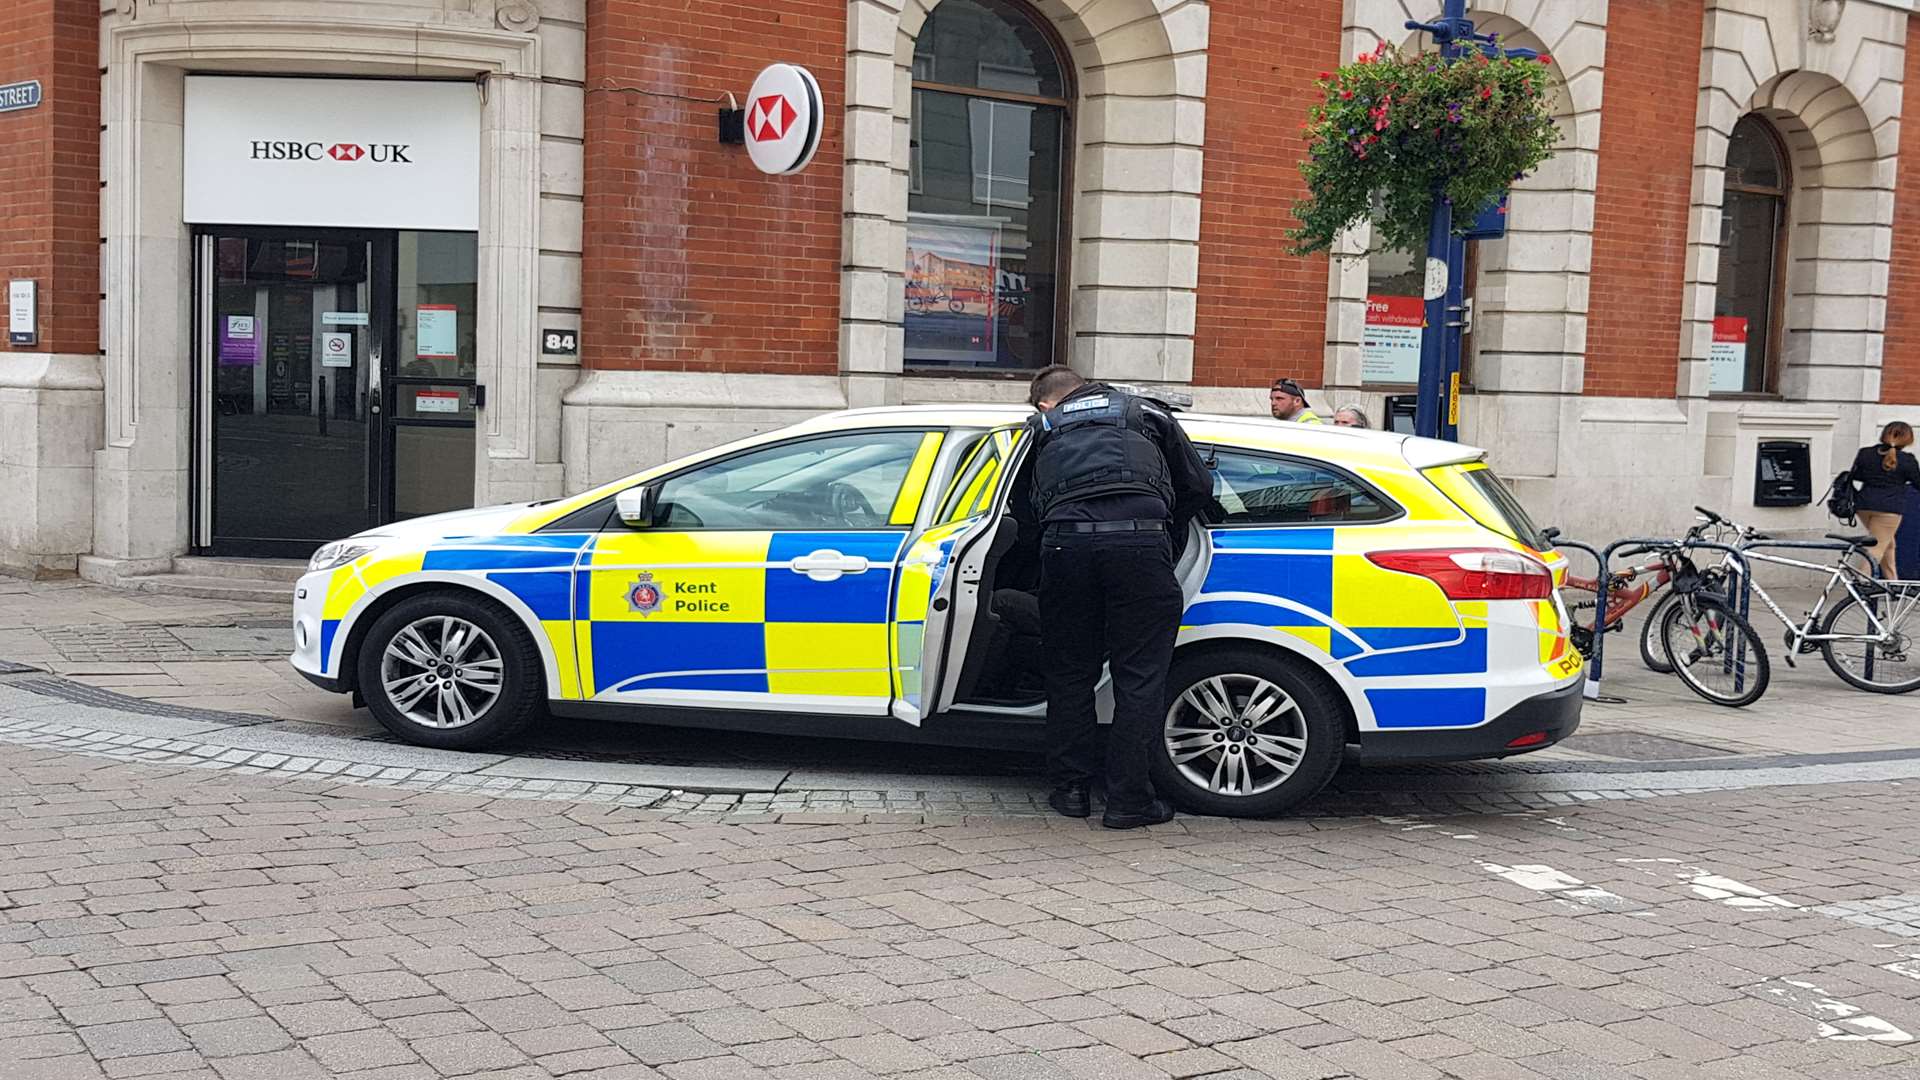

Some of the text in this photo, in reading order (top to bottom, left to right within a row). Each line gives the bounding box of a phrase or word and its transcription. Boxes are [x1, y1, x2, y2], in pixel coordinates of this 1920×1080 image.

[0, 86, 34, 107] STREET
[250, 141, 413, 163] HSBC UK
[1366, 300, 1389, 313] Free
[546, 334, 576, 350] 84
[1064, 398, 1109, 413] POLICE
[675, 582, 717, 593] Kent
[675, 600, 730, 612] Police
